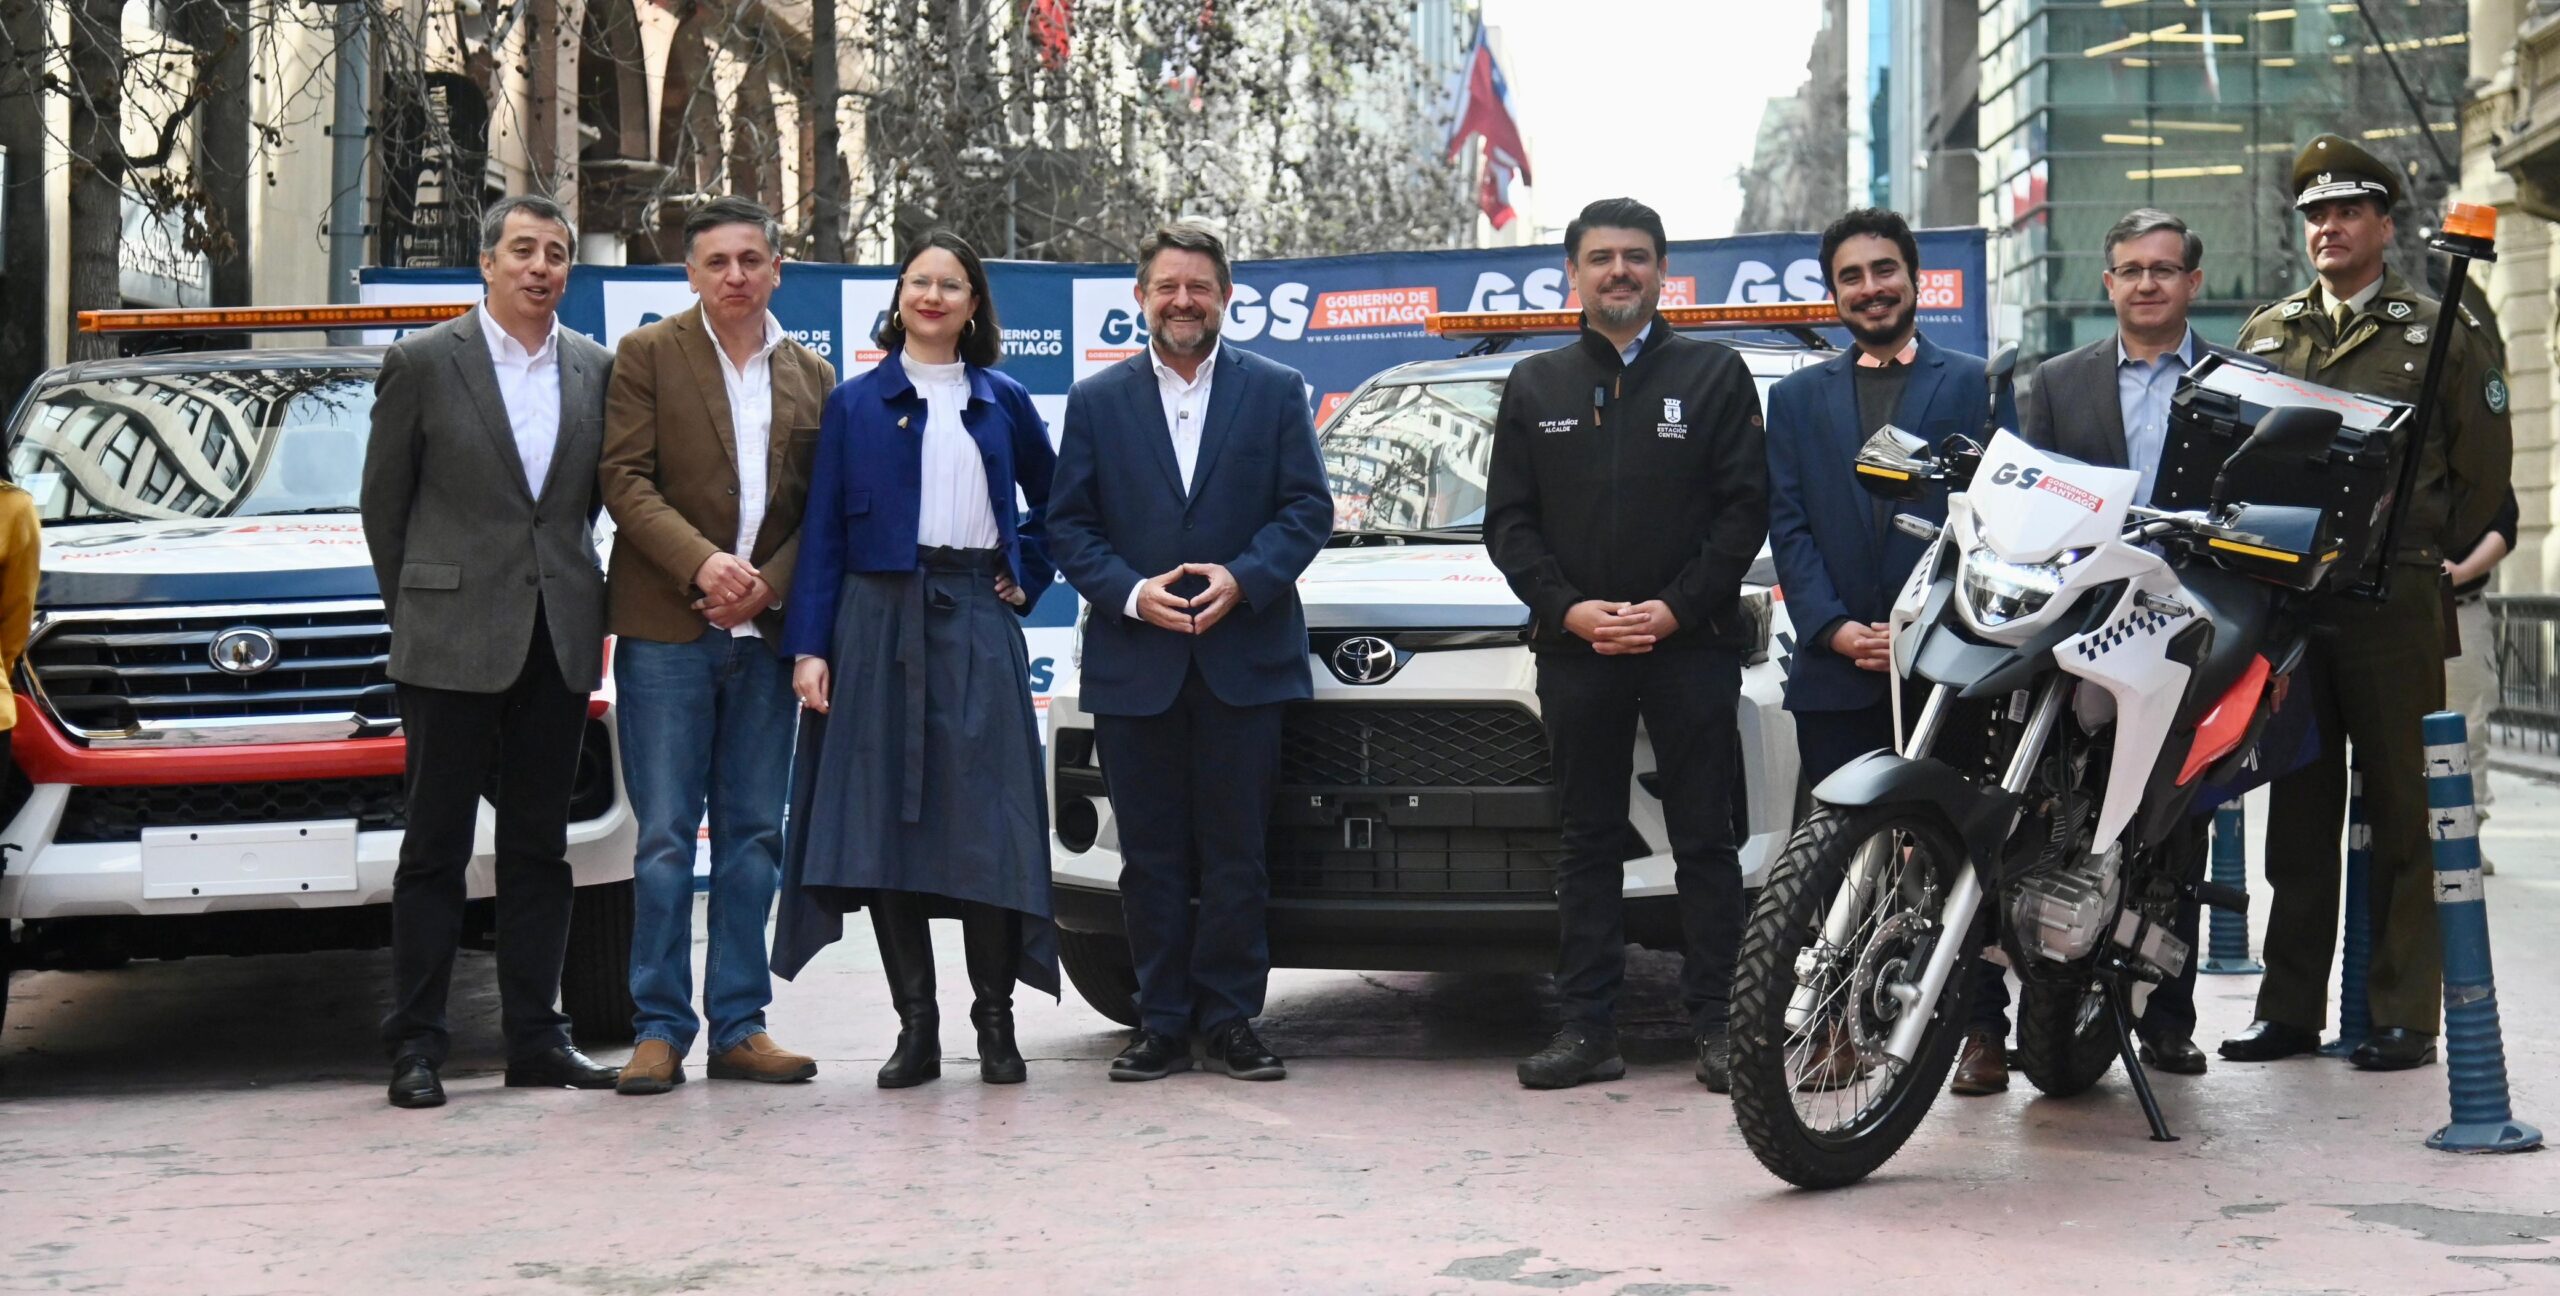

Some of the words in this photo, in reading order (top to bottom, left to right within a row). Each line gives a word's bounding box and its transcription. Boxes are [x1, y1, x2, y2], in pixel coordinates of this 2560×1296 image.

[1467, 267, 1563, 312] GS
[1669, 281, 1687, 292] DE
[1725, 258, 1826, 303] GS
[1932, 274, 1954, 286] DE
[1325, 293, 1405, 309] GOBIERNO
[1408, 291, 1430, 304] DE
[1220, 282, 1309, 341] GS
[1326, 305, 1431, 325] SANTIAGO
[812, 330, 830, 341] DE
[1000, 330, 1041, 340] IERNO
[1044, 330, 1062, 340] DE
[1000, 342, 1063, 355] NTIAGO
[1558, 418, 1578, 426] MUÑOZ
[1991, 463, 2043, 489] GS
[2045, 483, 2097, 510] SANTIAGO
[2047, 478, 2088, 498] GOBIERNO
[2089, 494, 2099, 503] DE
[60, 547, 158, 560] Nueva
[1030, 657, 1055, 692] S
